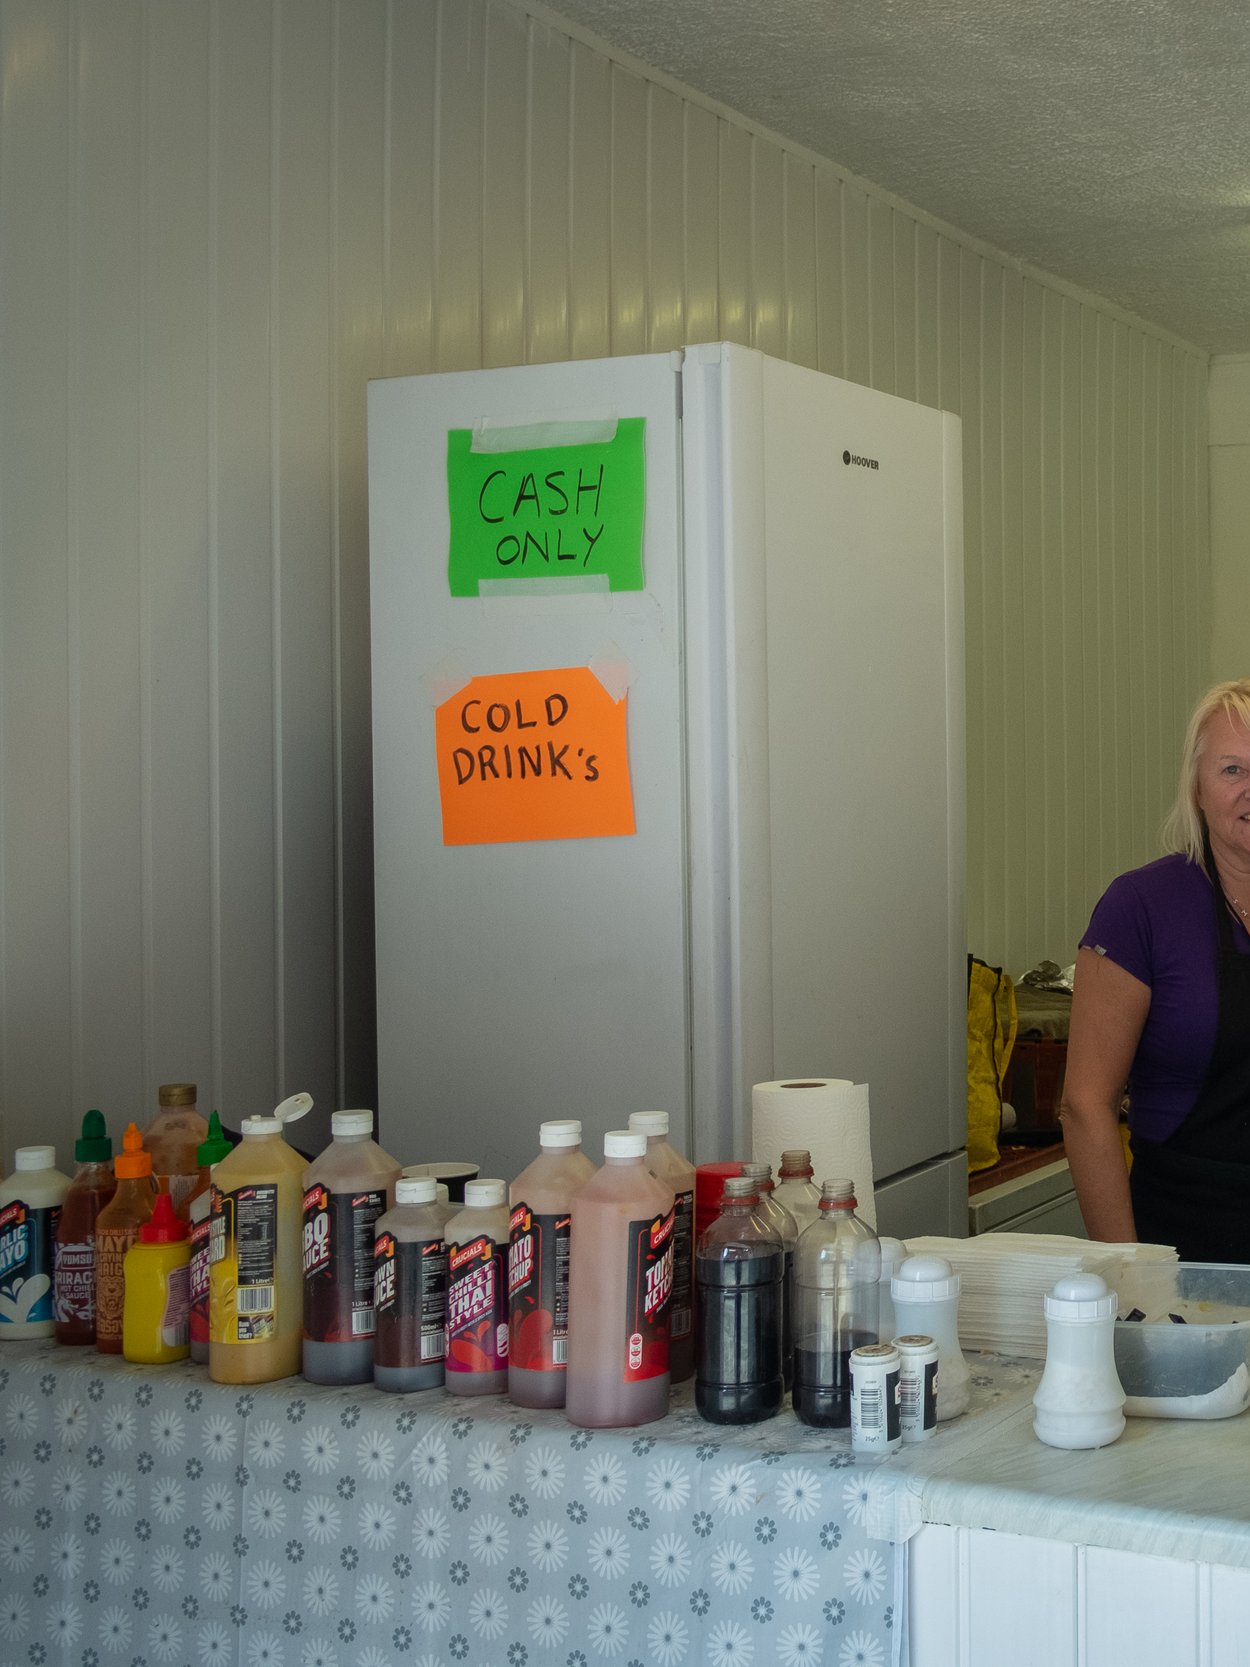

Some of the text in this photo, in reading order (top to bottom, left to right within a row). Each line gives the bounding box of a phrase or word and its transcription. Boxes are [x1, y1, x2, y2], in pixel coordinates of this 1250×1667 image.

[851, 454, 879, 471] HOOVER
[478, 464, 605, 524] CASH
[495, 524, 604, 567] ONLY
[461, 693, 569, 734] COLD
[453, 740, 600, 786] DRINK's
[303, 1213, 329, 1252] BQ
[452, 1242, 482, 1268] CRUCIALS
[645, 1239, 673, 1293] TOM
[56, 1271, 96, 1285] RIRAC
[449, 1260, 493, 1294] SWEET
[449, 1270, 493, 1305] CHILLI
[449, 1279, 493, 1319] THAI
[449, 1295, 493, 1330] STYLE
